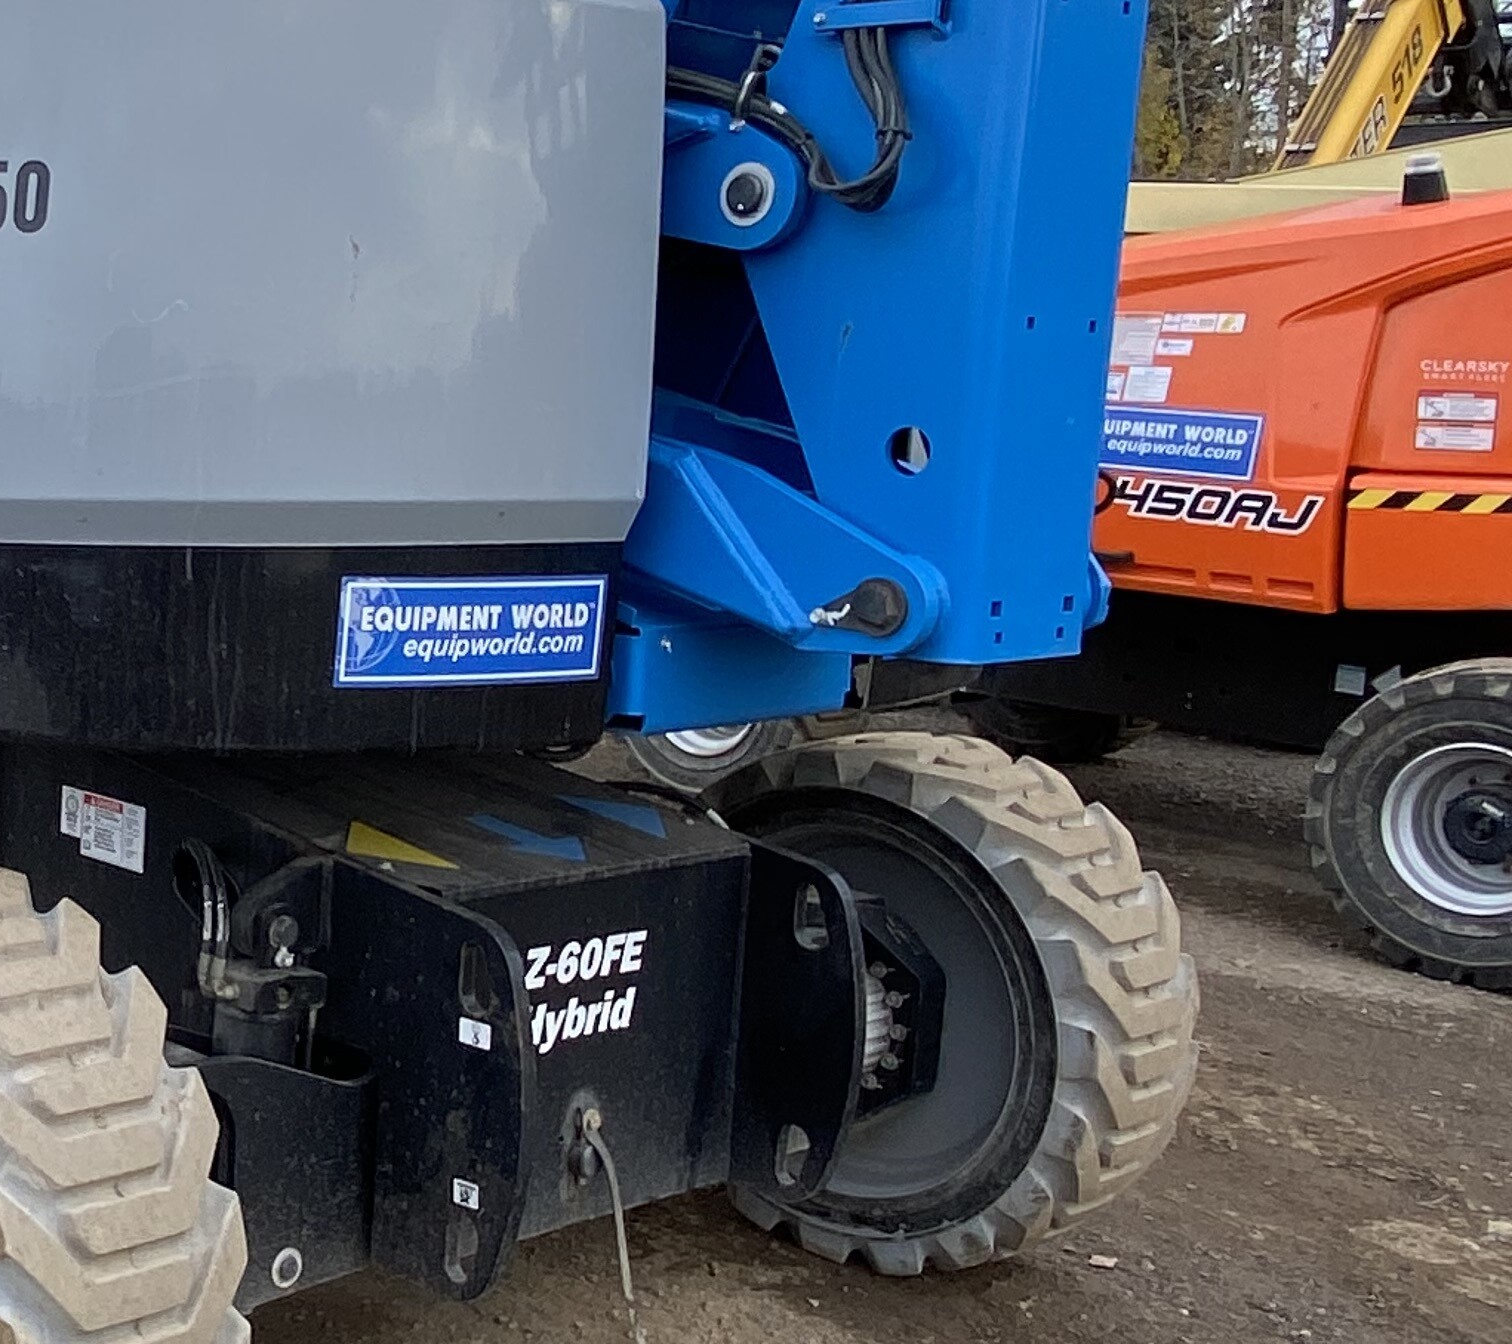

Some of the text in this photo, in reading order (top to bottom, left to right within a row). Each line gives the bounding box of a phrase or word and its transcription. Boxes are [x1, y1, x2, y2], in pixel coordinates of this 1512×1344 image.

[1419, 359, 1510, 373] CLEARSKY
[1104, 418, 1248, 446] UIPMENT WORLD
[1107, 437, 1243, 461] equipworld.com
[360, 602, 590, 633] EQUIPMENT WORLD
[402, 631, 585, 663] equipworld.com
[524, 929, 648, 991] Z-60FE
